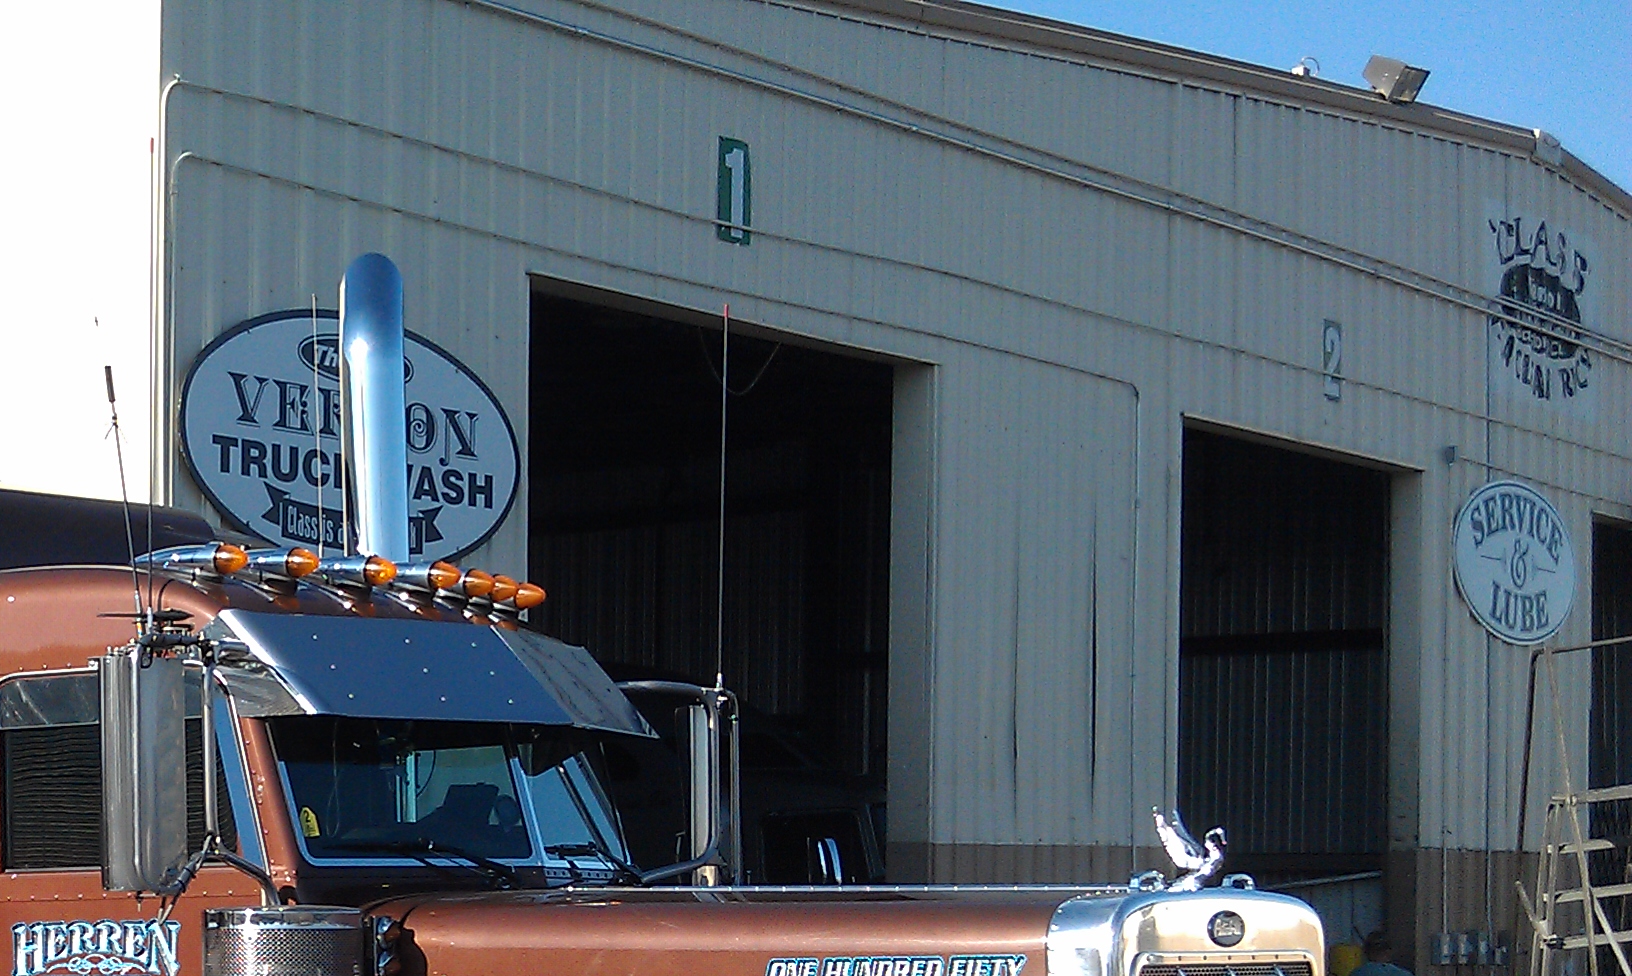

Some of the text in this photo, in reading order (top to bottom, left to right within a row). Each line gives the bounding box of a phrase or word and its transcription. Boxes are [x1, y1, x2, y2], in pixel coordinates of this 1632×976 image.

[725, 148, 744, 239] 1
[1325, 326, 1341, 398] 2
[227, 371, 479, 467] VERON
[406, 463, 494, 509] ASH
[287, 505, 318, 540] Class
[1470, 493, 1563, 566] SERVICE
[1510, 538, 1529, 590] &
[1489, 579, 1549, 632] LUBE
